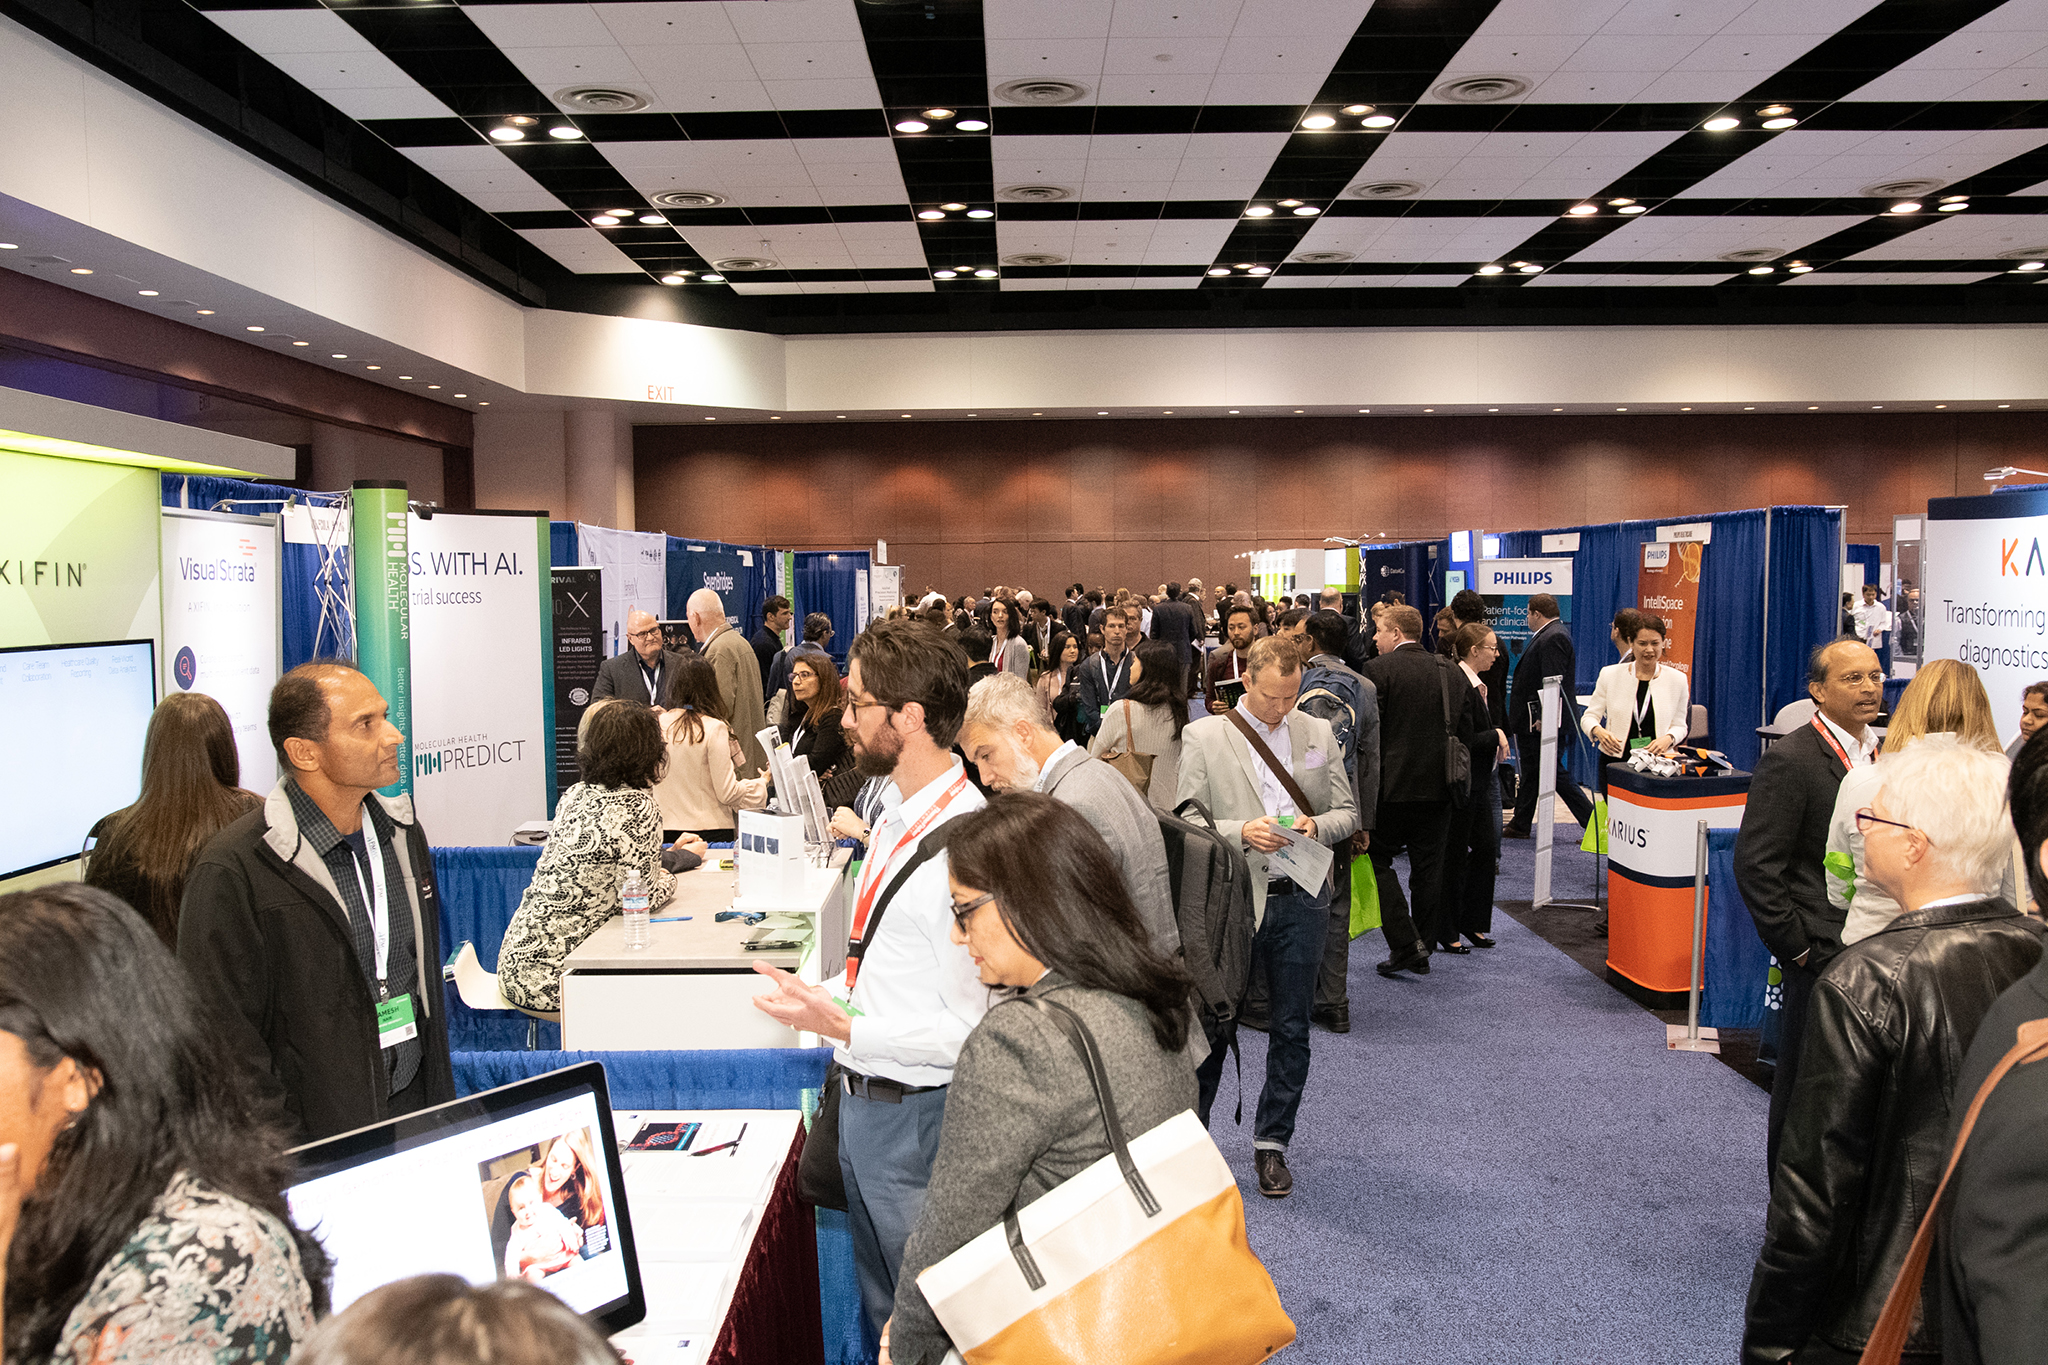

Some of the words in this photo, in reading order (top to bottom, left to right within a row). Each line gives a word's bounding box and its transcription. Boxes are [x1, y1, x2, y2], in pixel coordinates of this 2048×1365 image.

[648, 385, 674, 401] EXIT
[408, 552, 426, 576] S.
[430, 552, 487, 576] WITH
[494, 552, 523, 576] AI.
[1647, 550, 1668, 560] PHILIPS
[387, 562, 398, 610] HEALTH
[1494, 571, 1552, 585] PHILIPS
[399, 562, 409, 640] MOLECULAR
[412, 587, 433, 605] trial
[436, 591, 482, 605] success
[1644, 595, 1684, 612] IntelliSpace
[1943, 599, 2046, 636] Transforming
[571, 645, 593, 653] LIGHTS
[1960, 639, 2048, 671] diagnostics
[397, 667, 405, 694] Better
[414, 737, 456, 751] MOLECULAR
[458, 733, 488, 744] HEALTH
[443, 740, 526, 772] PREDICT
